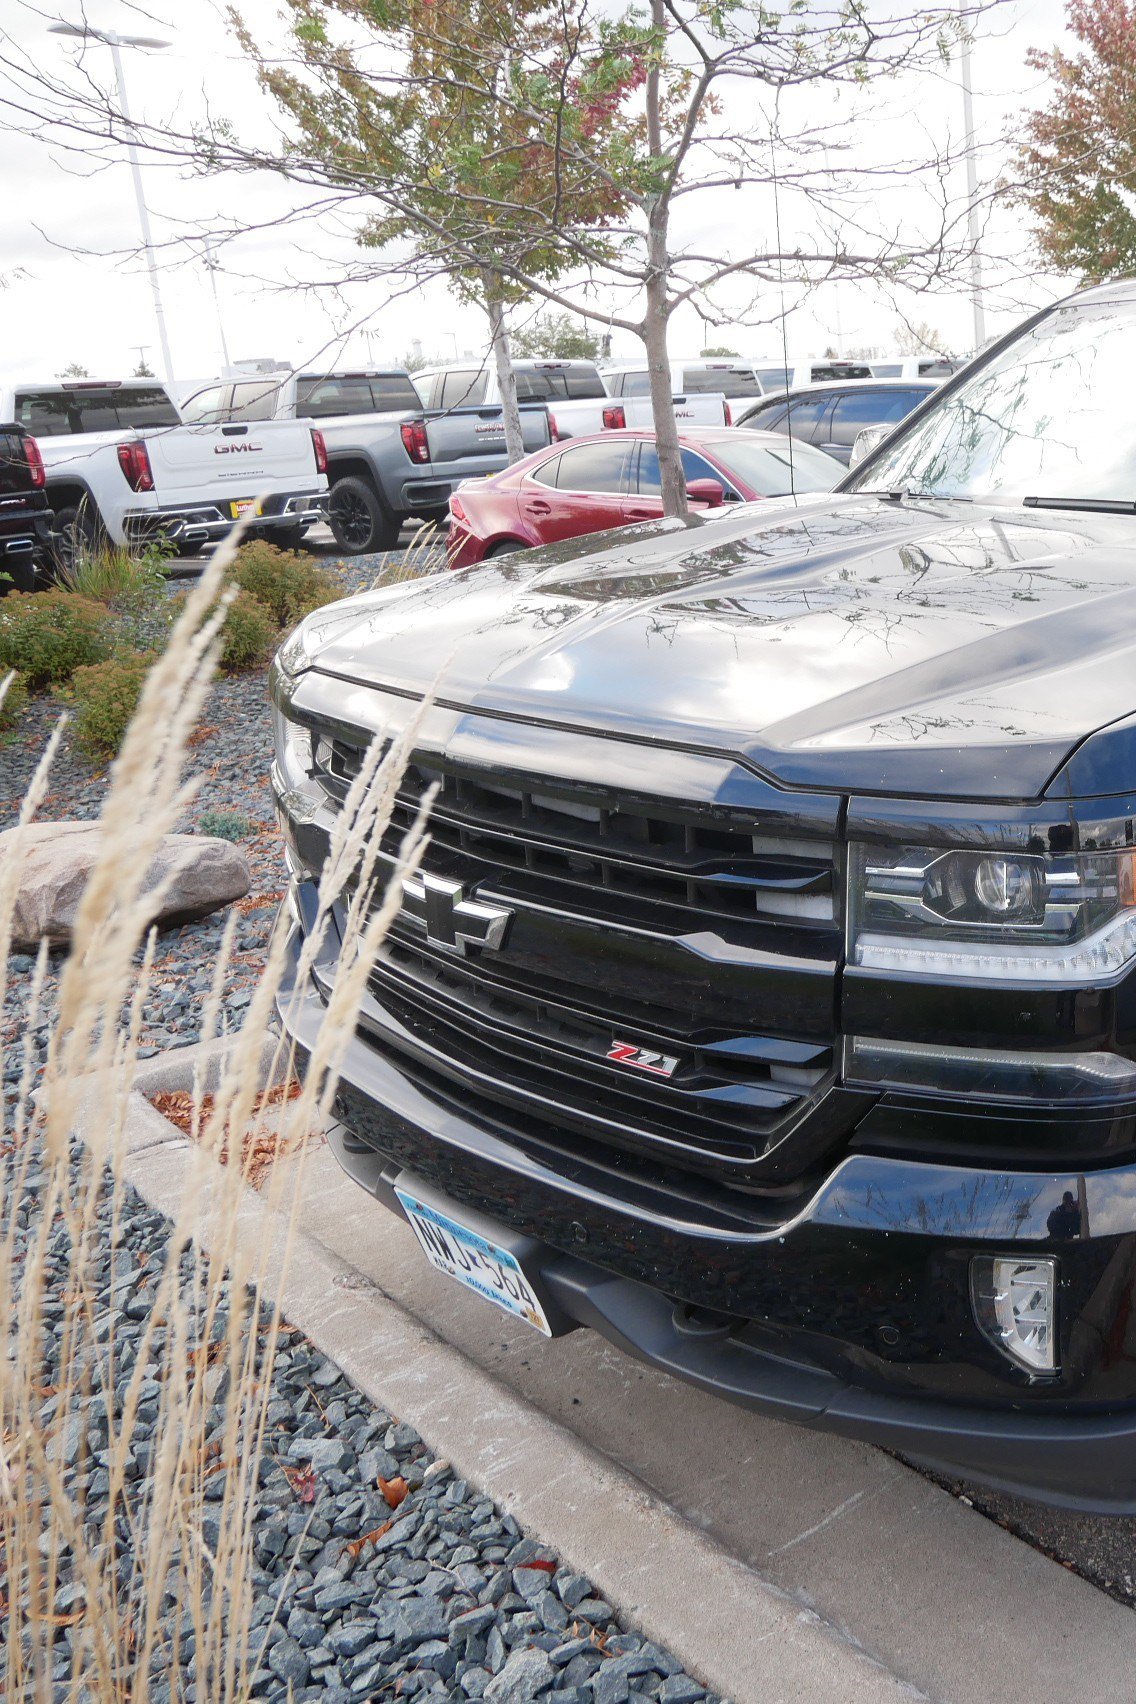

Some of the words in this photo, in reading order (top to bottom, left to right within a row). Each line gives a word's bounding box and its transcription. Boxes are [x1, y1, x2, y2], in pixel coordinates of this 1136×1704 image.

[675, 410, 695, 418] MC
[214, 441, 263, 455] GMC
[606, 1040, 681, 1077] Z71
